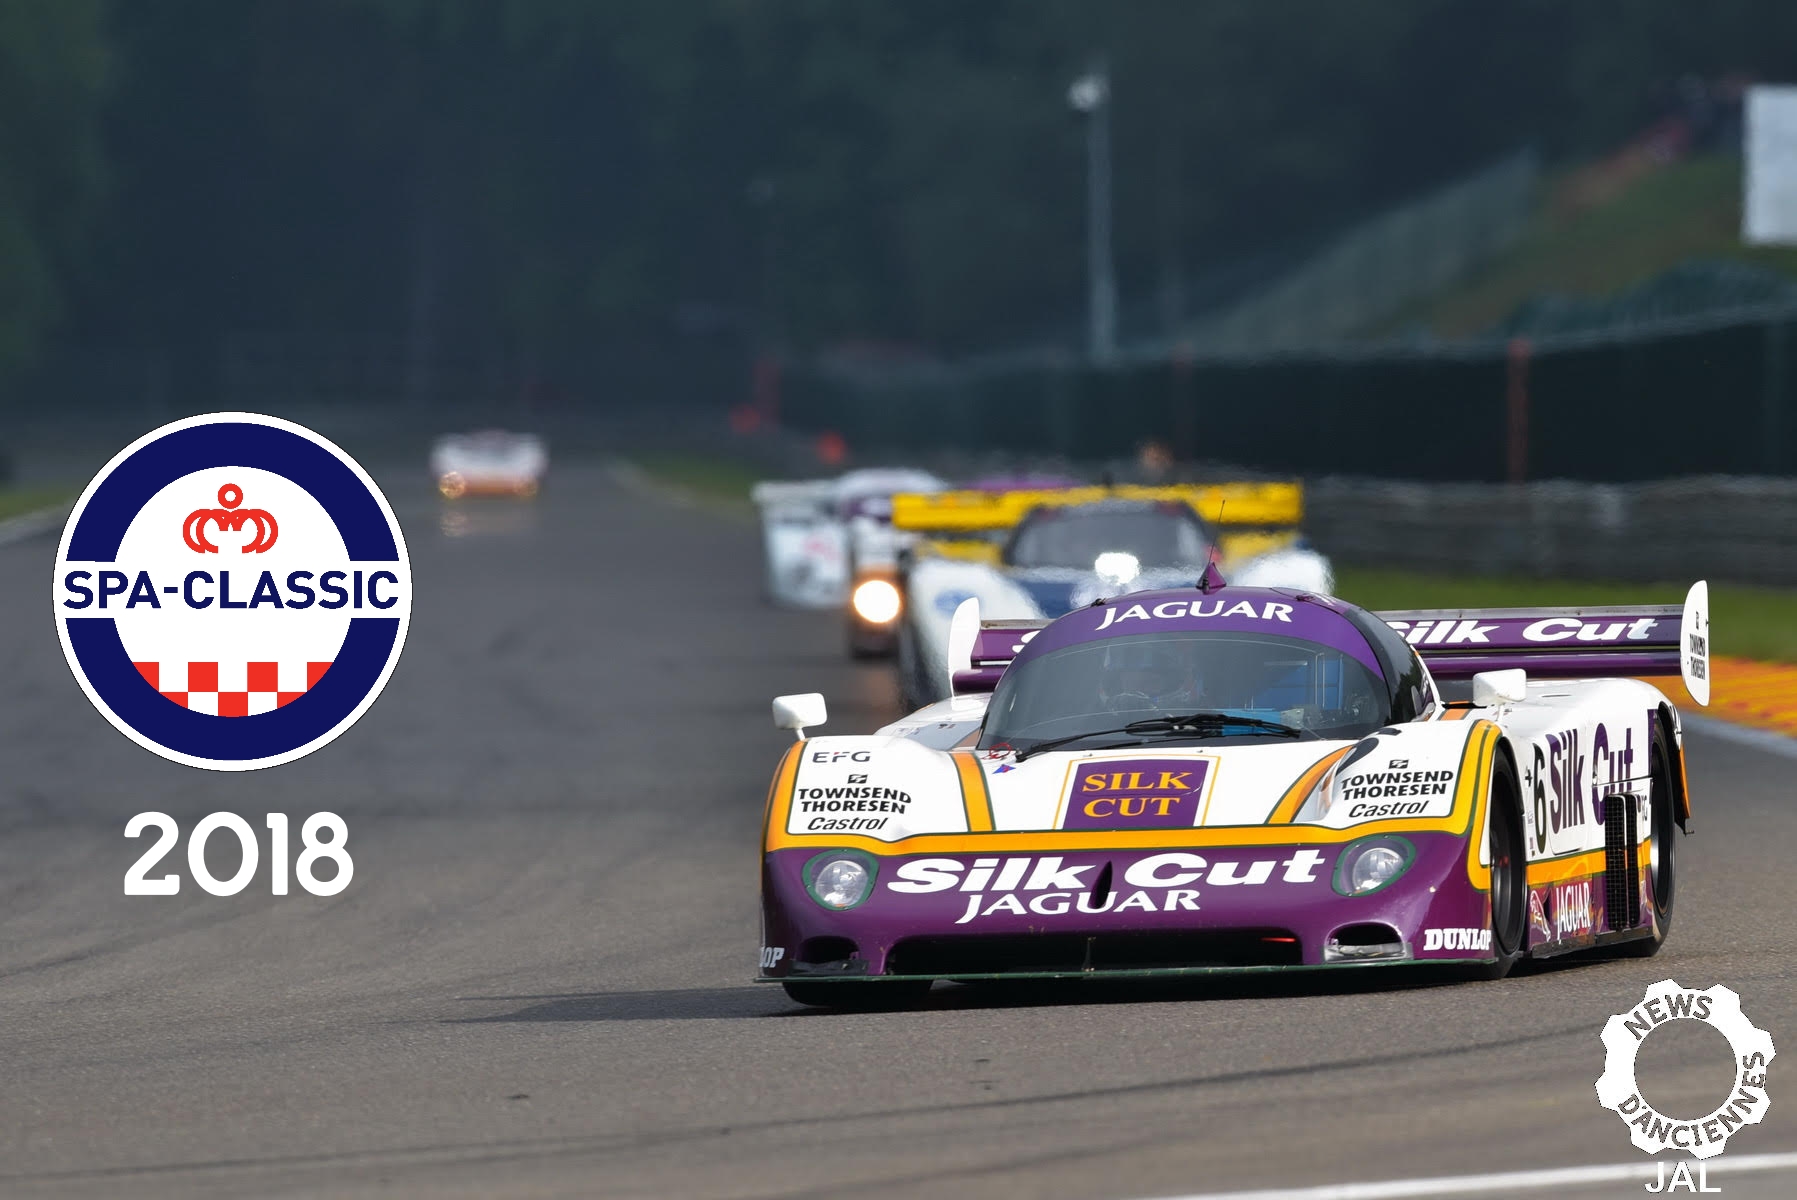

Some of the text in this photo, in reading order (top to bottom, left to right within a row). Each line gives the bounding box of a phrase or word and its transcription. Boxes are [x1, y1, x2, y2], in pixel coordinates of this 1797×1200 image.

[1095, 600, 1295, 632] JAGUAR
[1522, 617, 1659, 642] Cut
[812, 751, 871, 763] EFG
[1082, 771, 1192, 792] SILK
[1341, 770, 1454, 790] TOWNSEND
[1532, 722, 1633, 855] 6 Silk Cut
[798, 787, 912, 804] TOWNSEND
[1343, 783, 1447, 801] THORESEN
[801, 800, 906, 815] THORESEN
[1083, 797, 1180, 818] CUT
[1348, 800, 1430, 818] Castrol
[807, 817, 889, 831] Castrol
[887, 850, 1326, 894] Silk Cut
[955, 889, 1201, 924] JAGUAR
[1554, 881, 1591, 944] JAGUAR
[1423, 928, 1492, 951] DUNLOP
